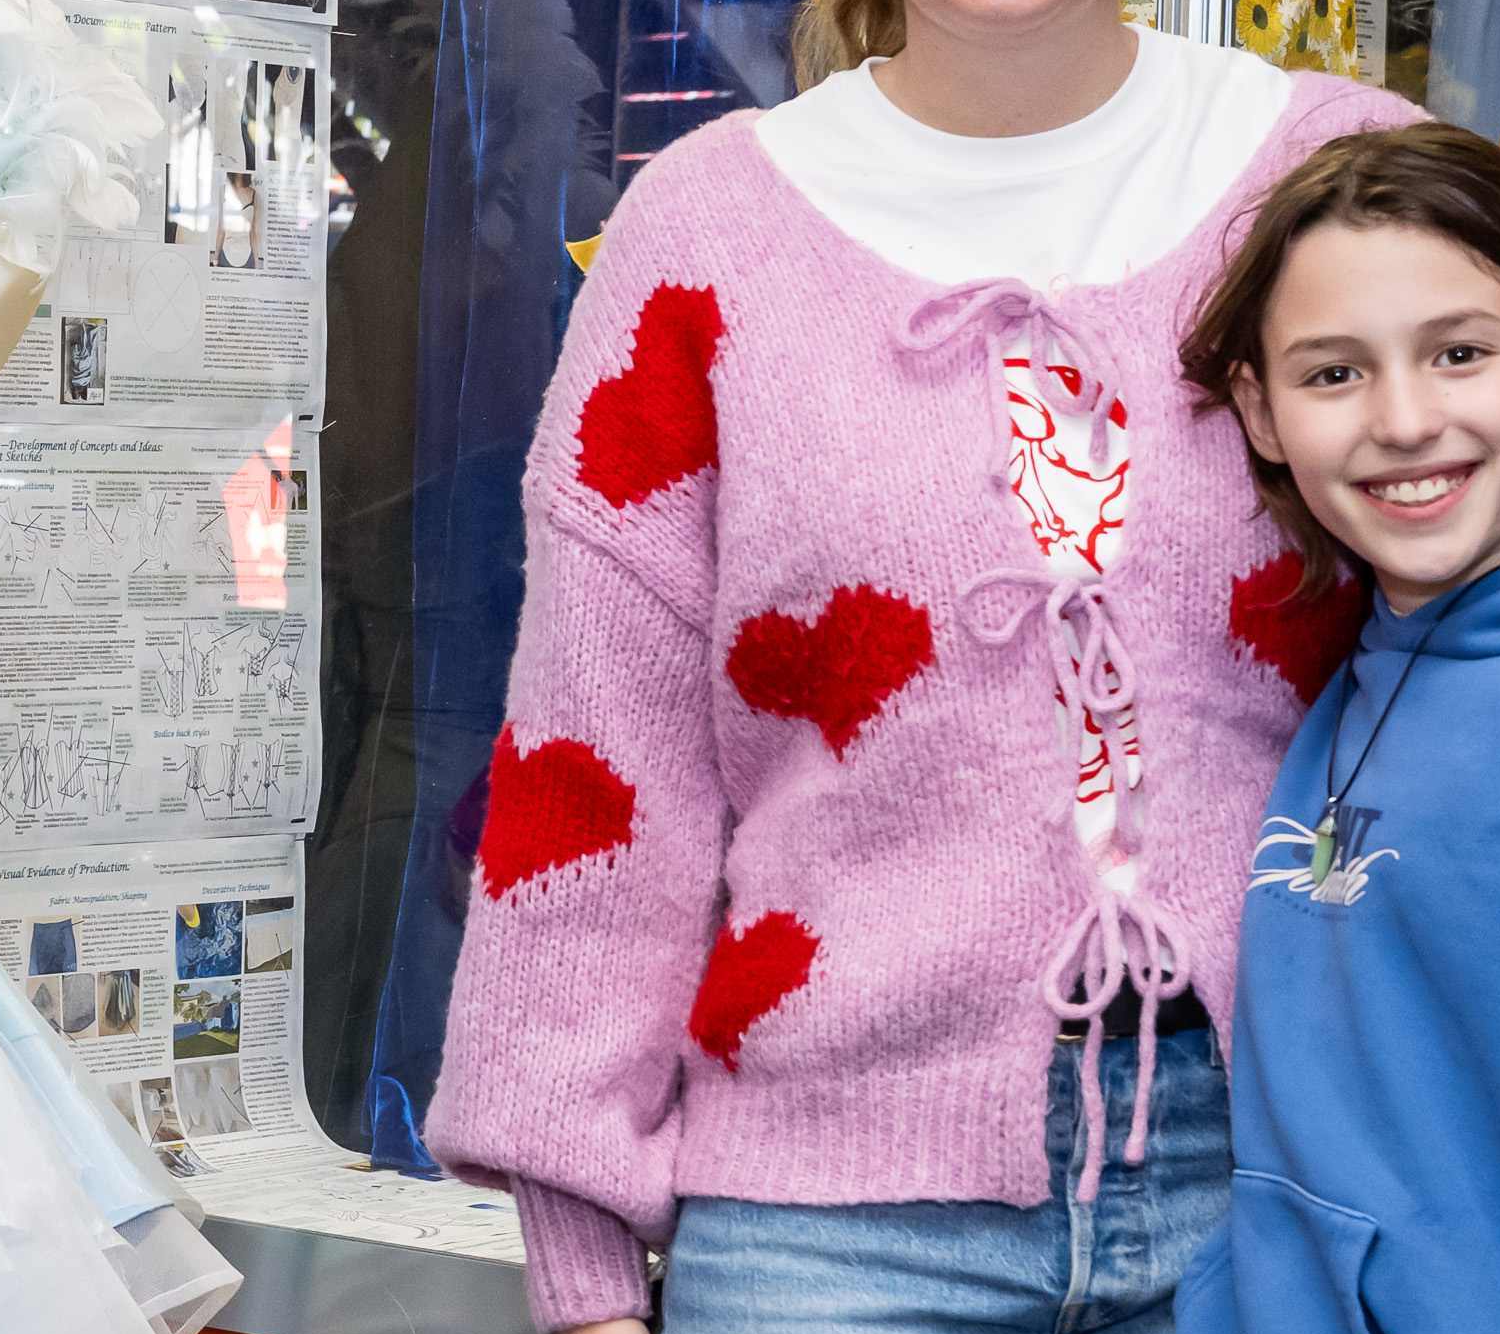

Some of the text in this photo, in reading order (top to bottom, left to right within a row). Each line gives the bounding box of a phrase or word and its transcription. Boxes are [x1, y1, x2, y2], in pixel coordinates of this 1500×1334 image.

[145, 21, 177, 34] Pattern
[69, 439, 80, 456] of
[80, 441, 118, 456] Concepts
[120, 441, 136, 452] and
[139, 441, 164, 452] Ideas:
[5, 451, 43, 462] Sketches
[27, 866, 65, 879] Evidence
[68, 862, 76, 879] of
[79, 862, 130, 875] Production:
